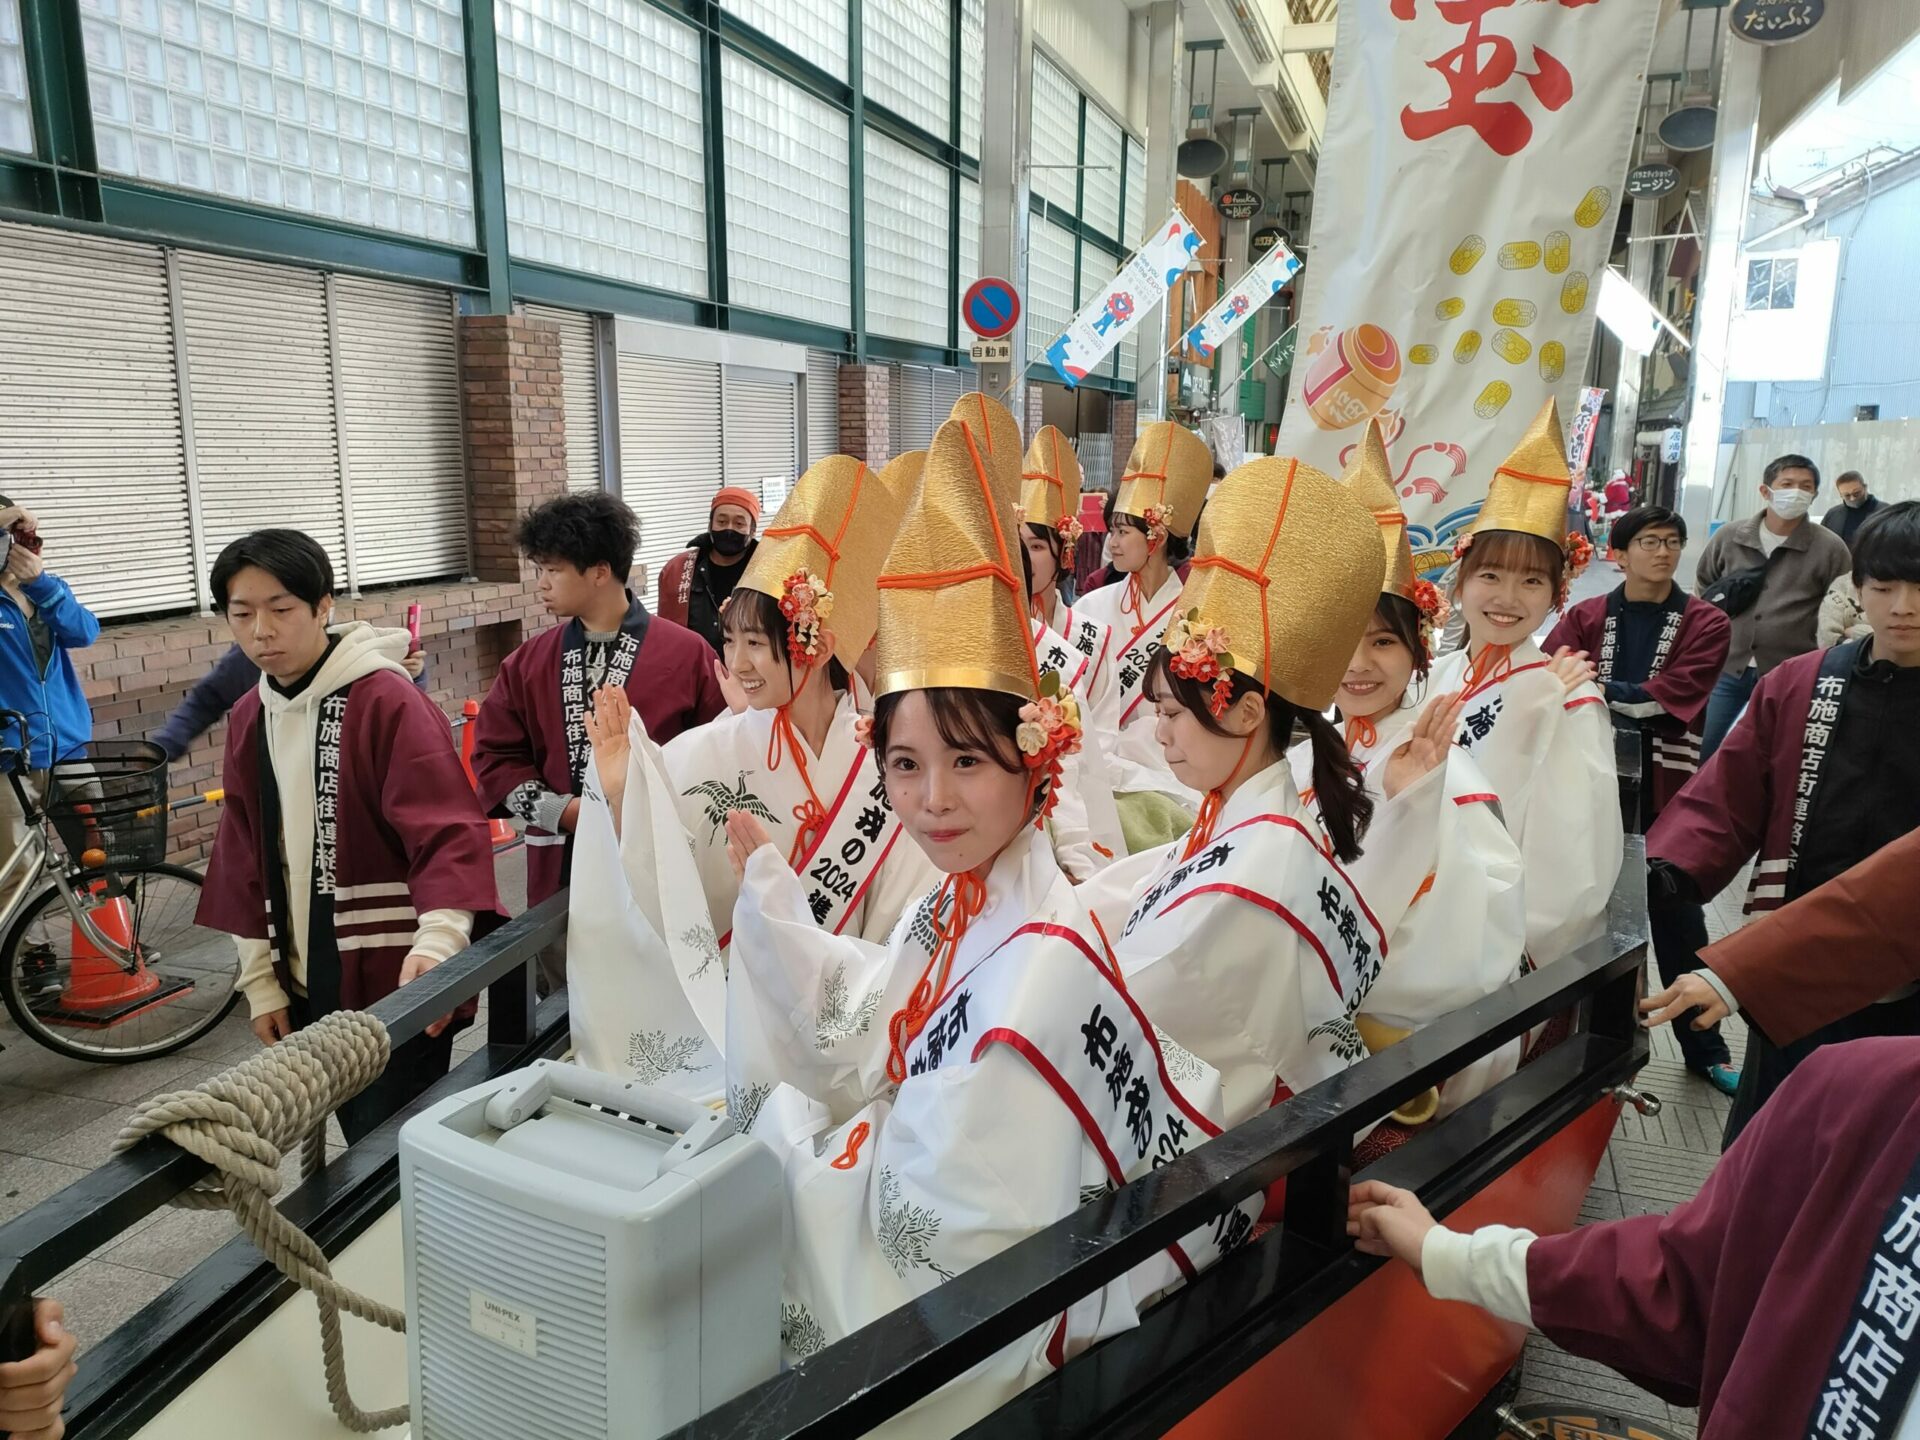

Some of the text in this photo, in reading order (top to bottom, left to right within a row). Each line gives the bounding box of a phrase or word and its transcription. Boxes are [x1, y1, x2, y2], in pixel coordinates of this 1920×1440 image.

[1630, 178, 1676, 191] ユージン
[1146, 276, 1164, 295] EXPO
[972, 346, 1009, 357] 自動車
[810, 857, 858, 902] 2024
